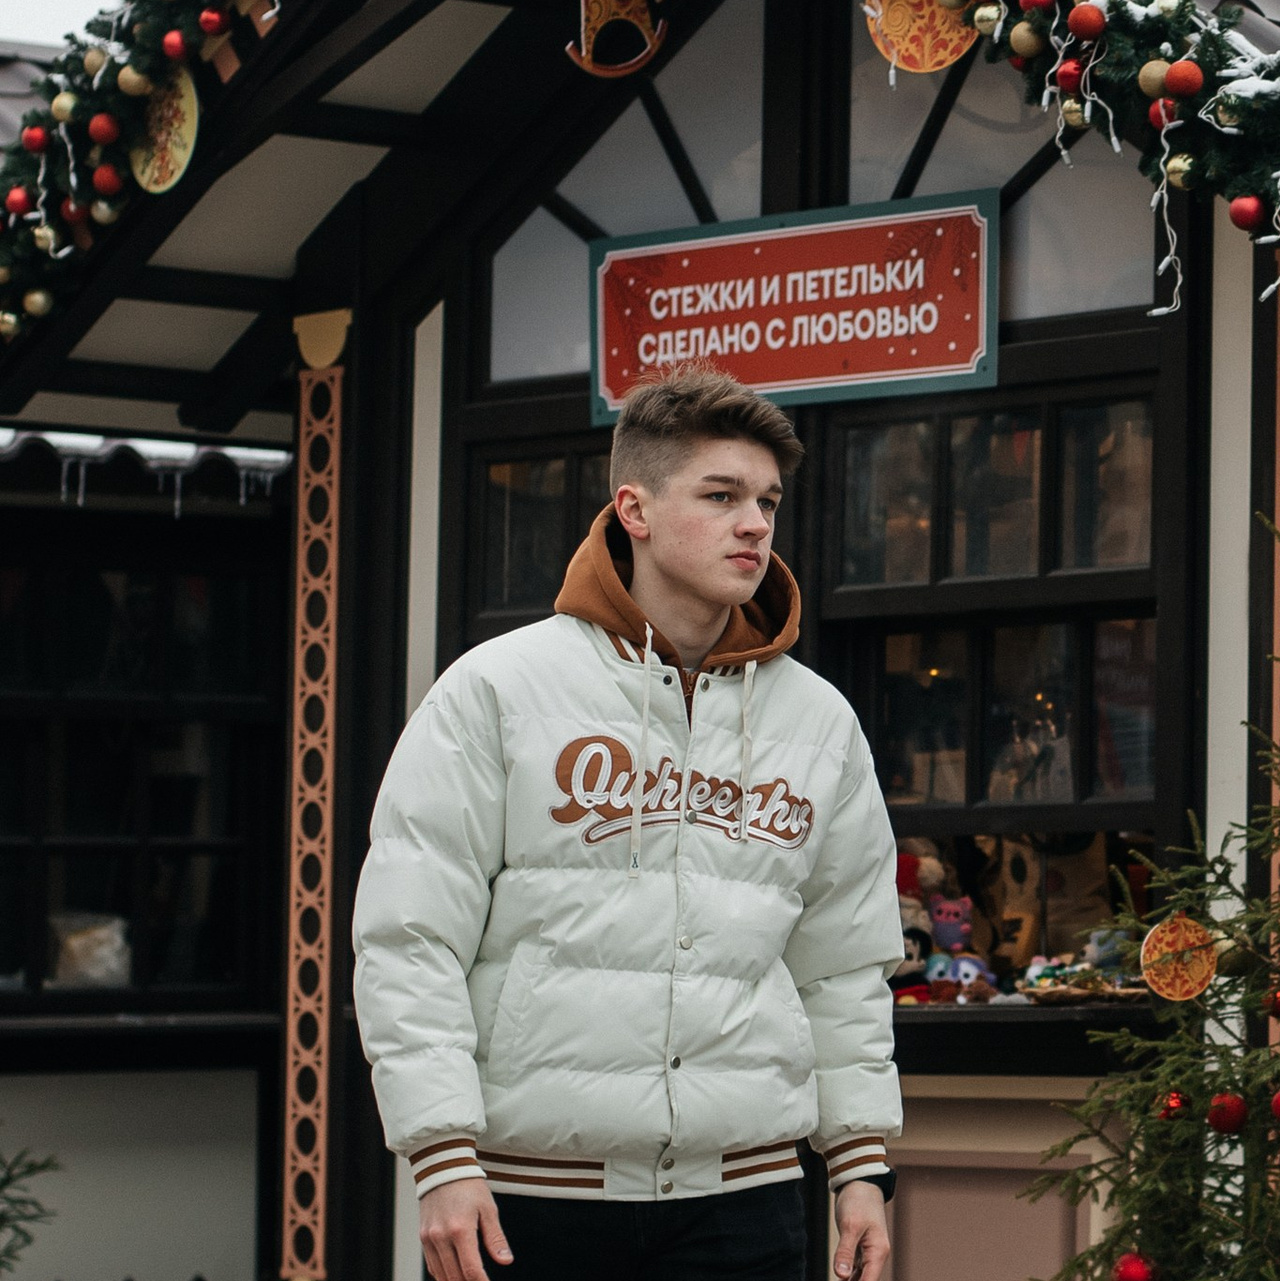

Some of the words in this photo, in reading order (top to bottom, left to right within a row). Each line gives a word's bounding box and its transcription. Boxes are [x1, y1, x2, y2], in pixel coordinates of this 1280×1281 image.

[650, 281, 755, 320] СТЕЖКИ
[760, 274, 780, 307] И
[786, 258, 924, 303] ПЕТЕЛЬКИ
[638, 321, 761, 366] СДЕЛАНО
[765, 318, 786, 350] С
[789, 302, 939, 347] ЛЮБОВЬЮ
